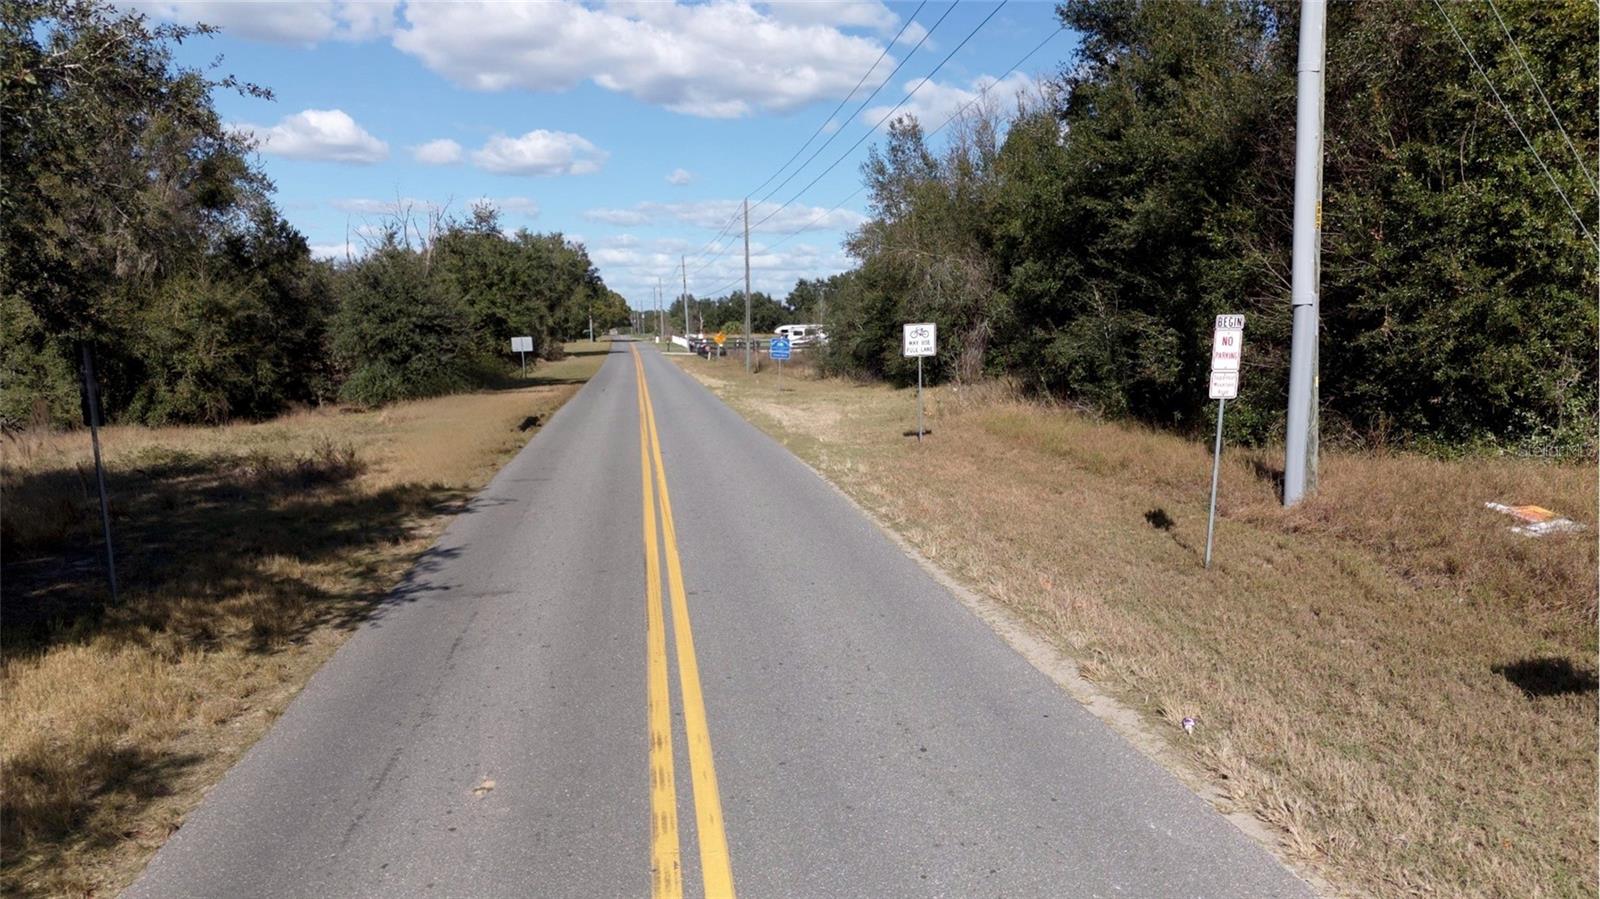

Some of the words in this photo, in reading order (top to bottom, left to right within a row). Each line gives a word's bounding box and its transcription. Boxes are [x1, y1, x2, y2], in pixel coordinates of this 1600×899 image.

[1217, 316, 1243, 328] BEGIN
[1222, 336, 1234, 346] NO
[1216, 352, 1238, 360] PARKING
